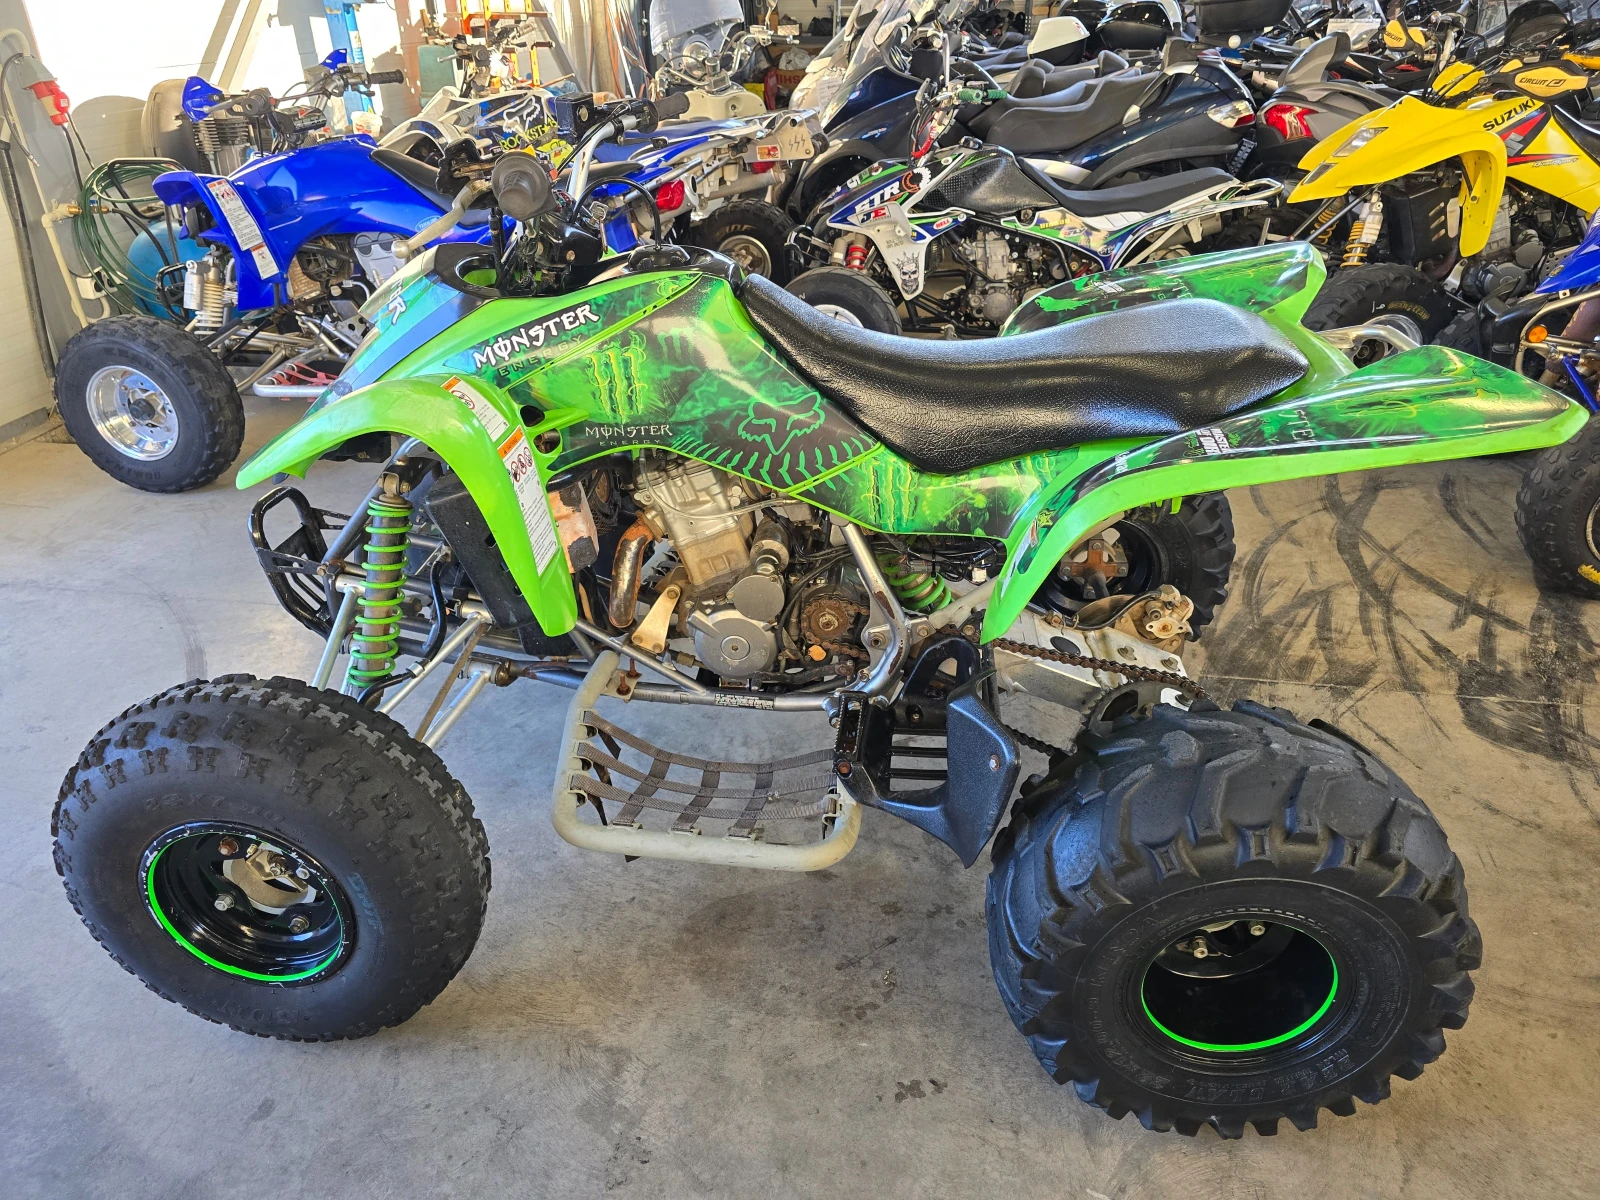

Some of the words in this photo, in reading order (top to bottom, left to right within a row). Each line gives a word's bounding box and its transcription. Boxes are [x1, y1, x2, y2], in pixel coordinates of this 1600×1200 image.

[1519, 76, 1548, 85] CIRCUIT
[1482, 99, 1536, 132] SUZUKI
[859, 206, 887, 223] JE
[934, 218, 951, 229] BELL
[473, 303, 600, 369] MONSTER
[499, 335, 583, 377] ENERGY
[585, 424, 673, 440] MONSTER
[599, 438, 661, 447] ENERGY
